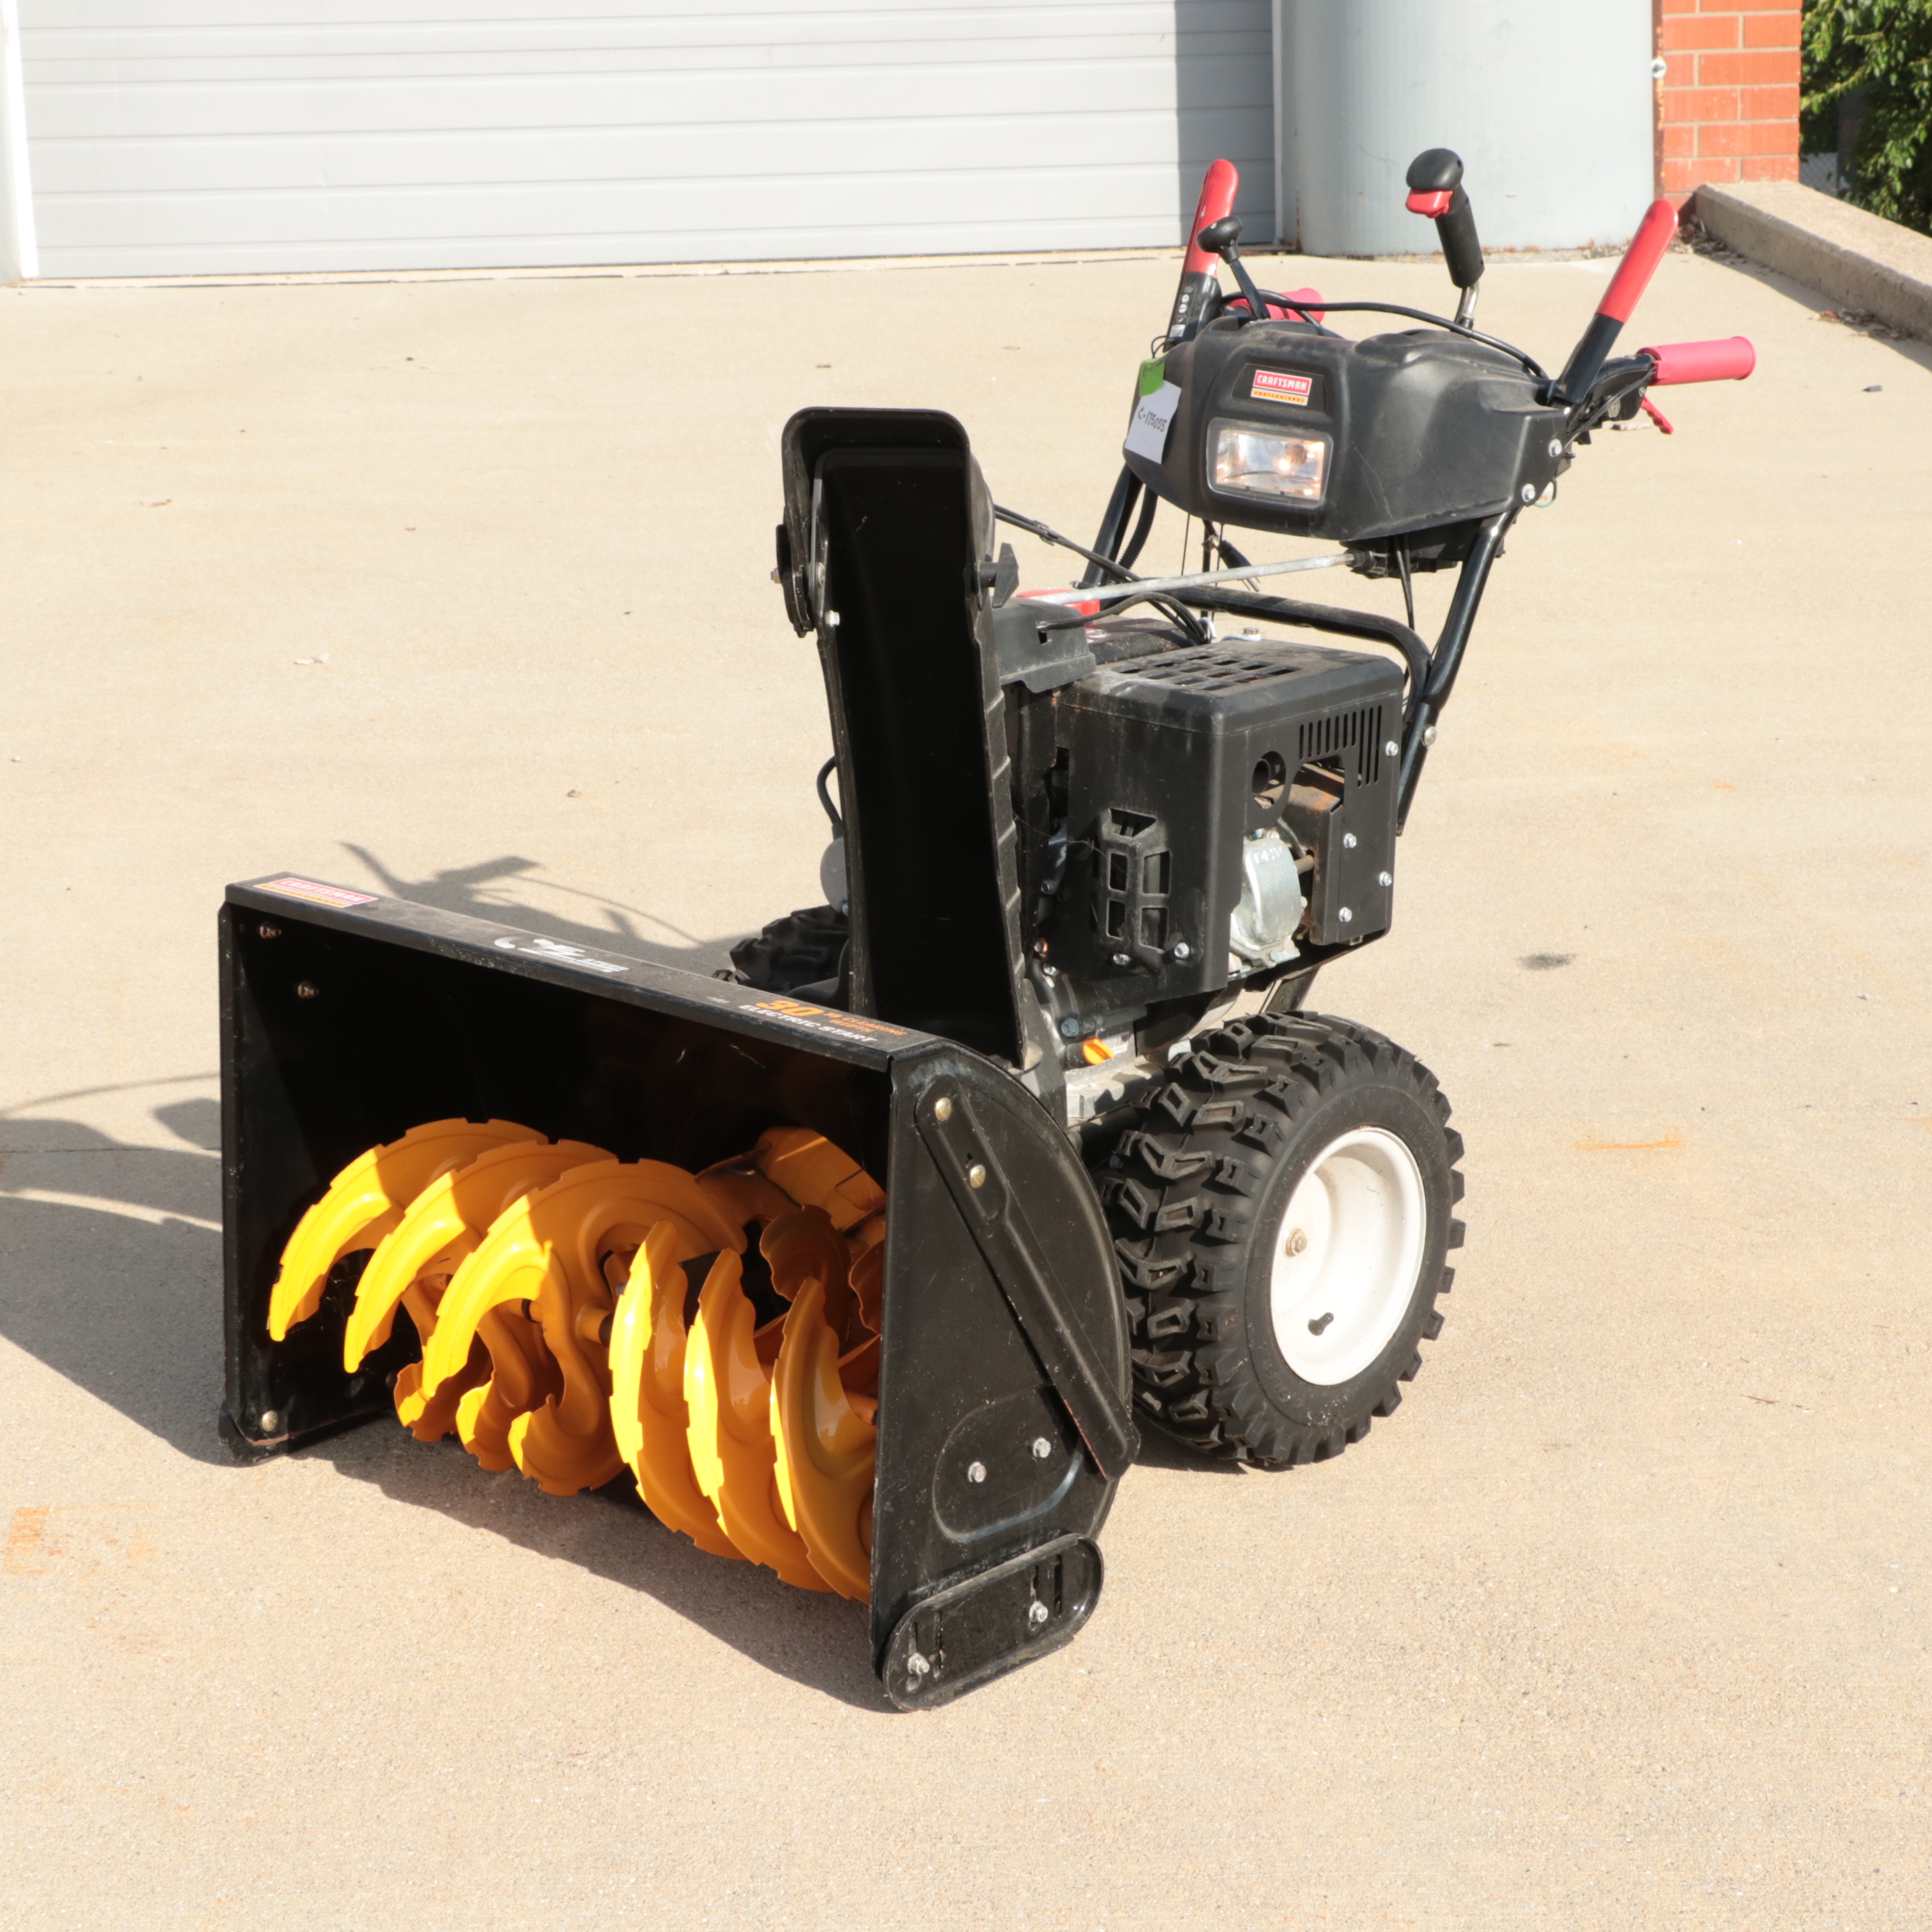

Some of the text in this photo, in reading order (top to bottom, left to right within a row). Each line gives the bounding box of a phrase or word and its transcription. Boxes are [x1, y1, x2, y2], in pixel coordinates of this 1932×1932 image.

[1257, 374, 1307, 391] CRAFTSMAN
[281, 880, 366, 902] CRAFTSMAN
[738, 1005, 878, 1042] ELECTRIC START
[755, 999, 824, 1016] 30
[841, 1017, 907, 1036] CLEARING
[828, 1018, 875, 1033] WIDTH
